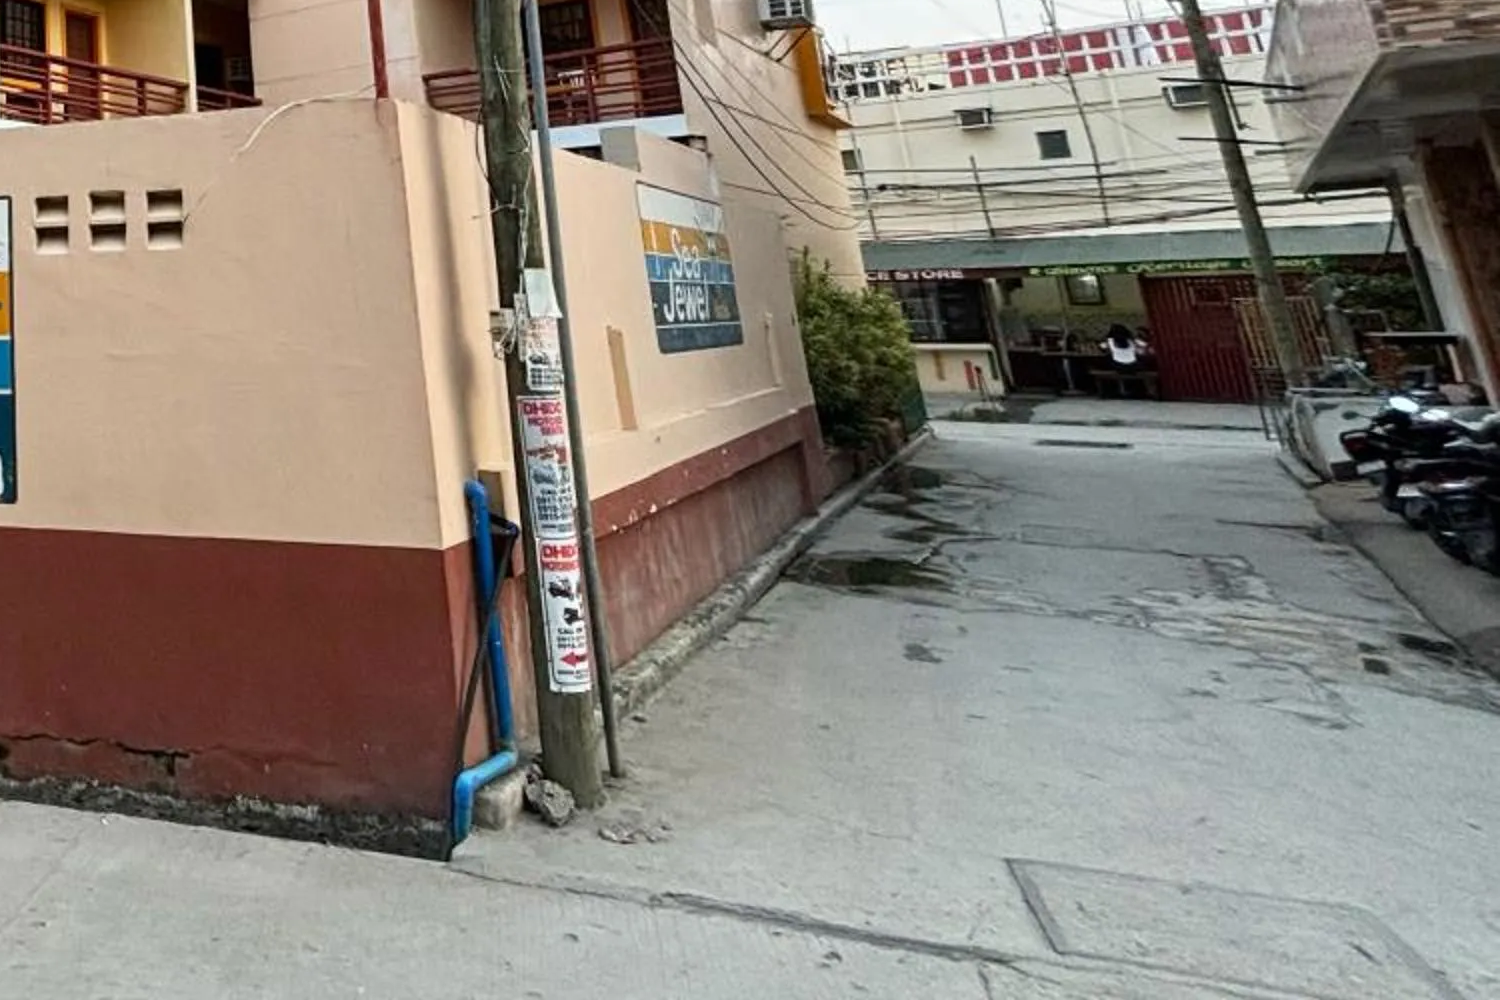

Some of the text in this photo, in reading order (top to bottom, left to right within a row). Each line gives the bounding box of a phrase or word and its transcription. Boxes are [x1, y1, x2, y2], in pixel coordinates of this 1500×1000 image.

[670, 228, 701, 279] Sea
[895, 268, 965, 281] STORE
[663, 268, 711, 323] Jewel
